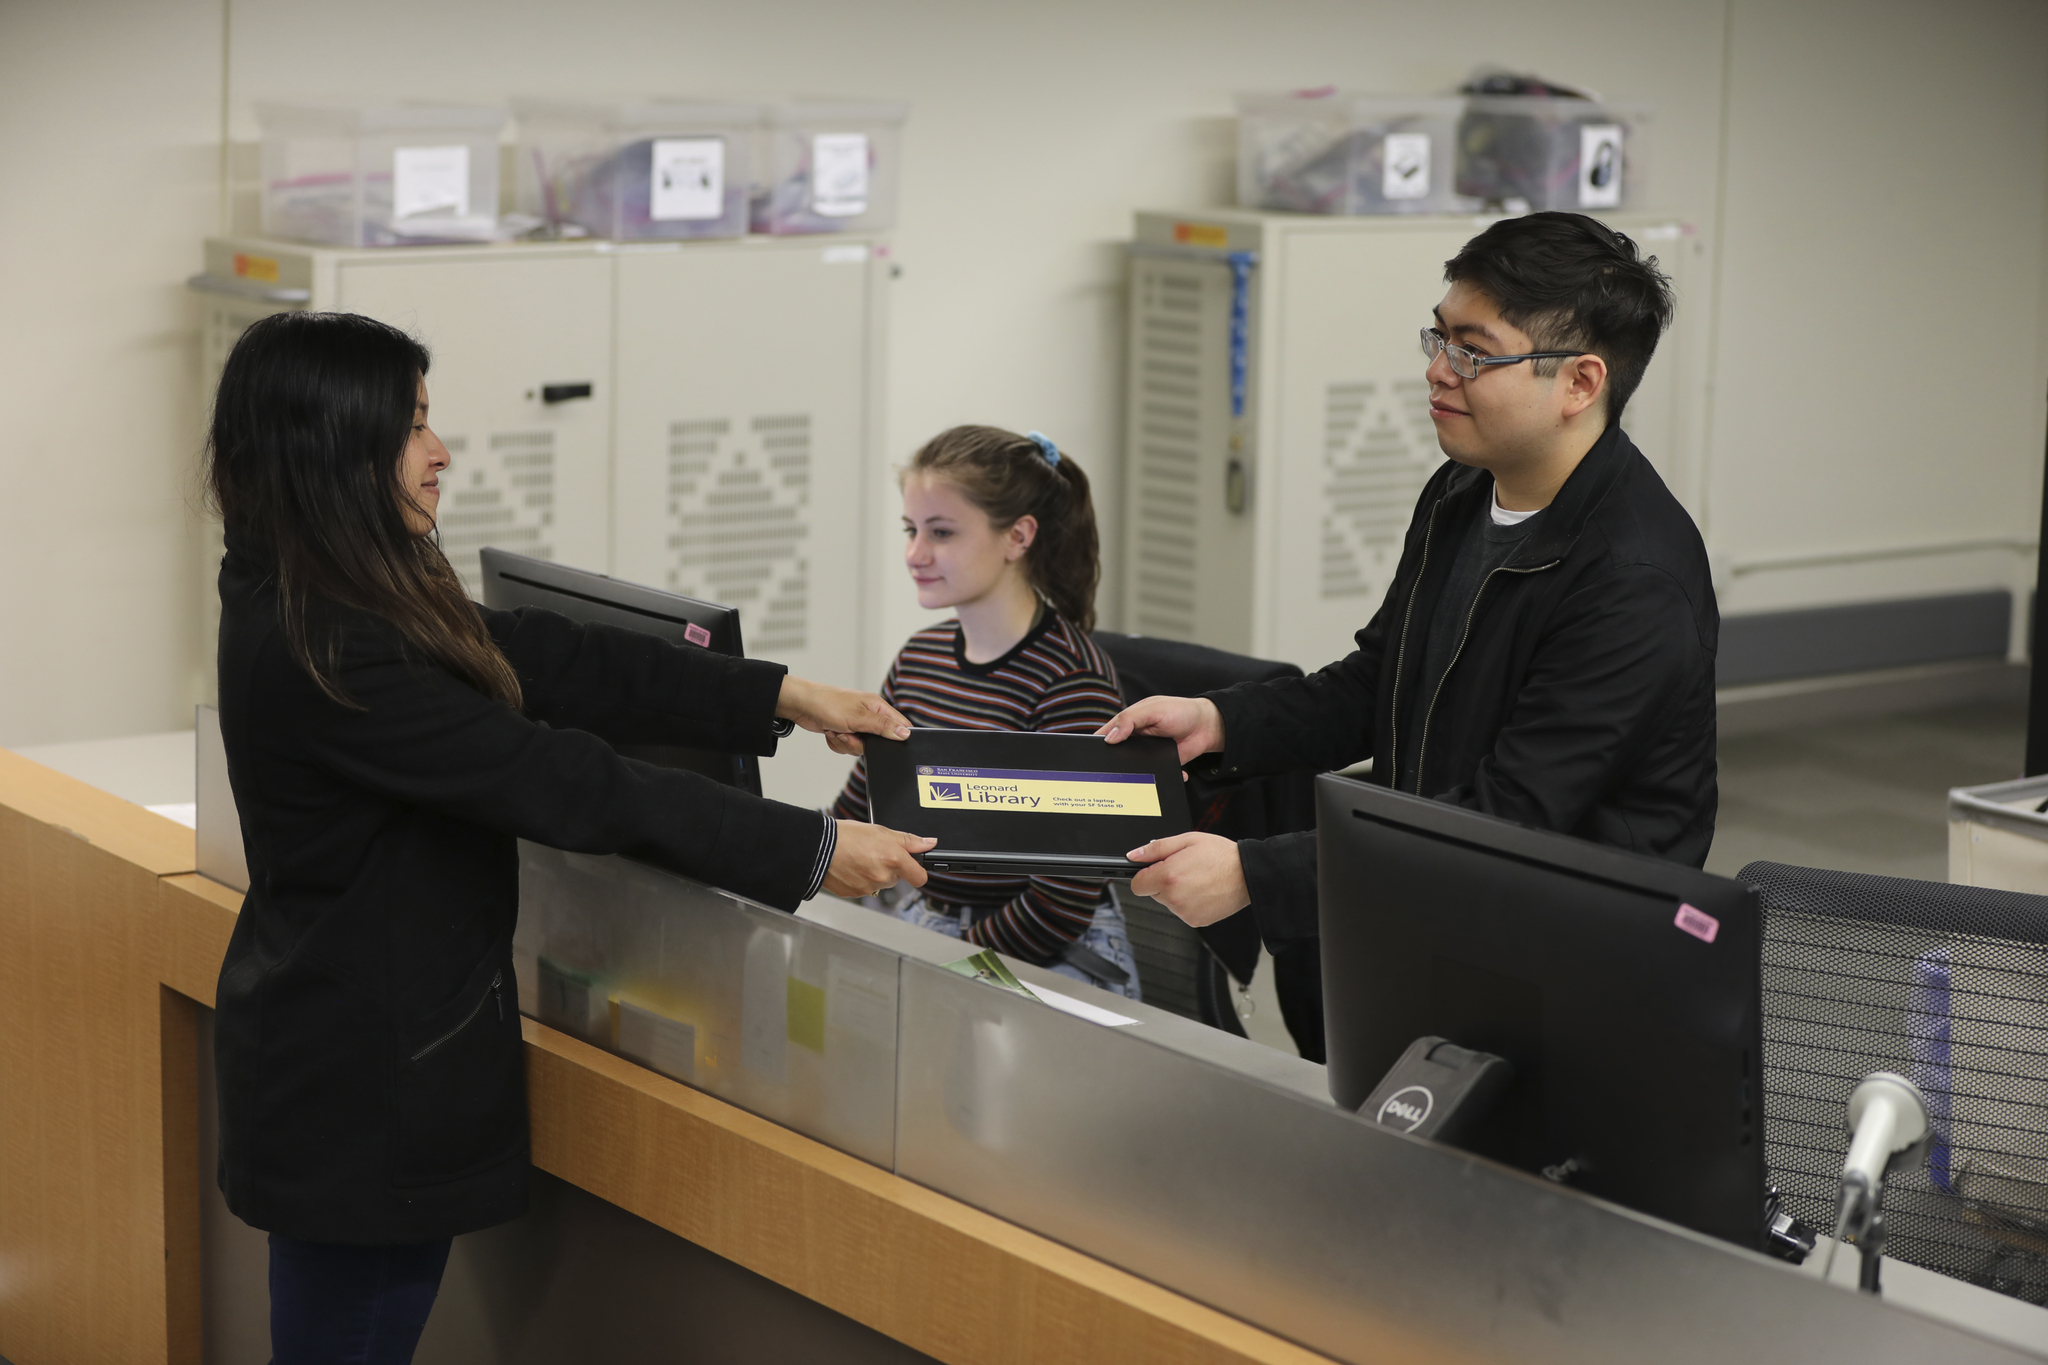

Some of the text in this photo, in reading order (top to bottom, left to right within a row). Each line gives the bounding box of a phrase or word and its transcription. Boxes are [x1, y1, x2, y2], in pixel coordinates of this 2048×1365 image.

[967, 783, 1018, 792] Leonard
[968, 791, 1041, 808] Library
[1386, 1100, 1422, 1122] DELL
